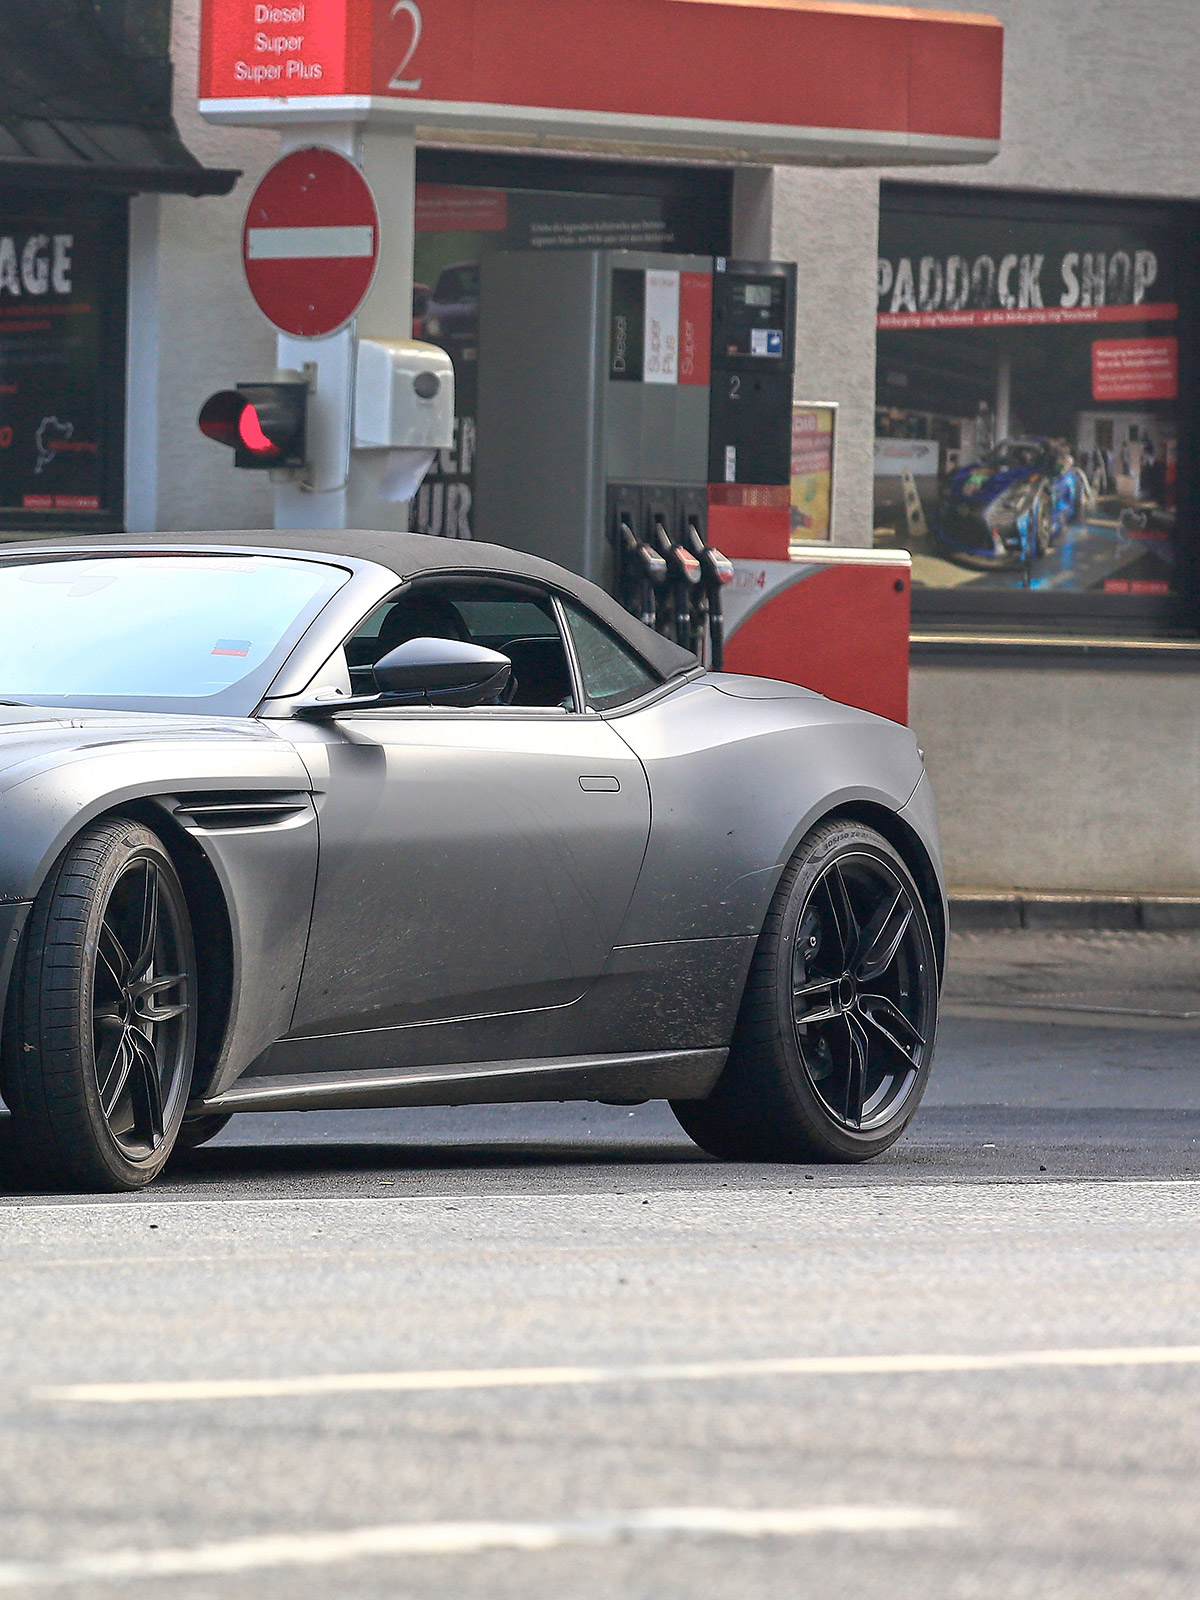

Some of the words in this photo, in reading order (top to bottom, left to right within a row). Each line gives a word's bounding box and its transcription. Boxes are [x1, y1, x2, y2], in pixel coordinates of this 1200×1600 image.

[254, 4, 305, 24] Diesel
[234, 60, 282, 83] Super
[286, 59, 323, 79] Plus
[254, 32, 304, 55] Super
[388, 0, 423, 91] 2
[878, 253, 1045, 313] PADDOCK
[1059, 250, 1158, 309] SHOP
[613, 315, 627, 373] Diesel
[648, 319, 661, 374] Super
[681, 320, 695, 376] Super
[729, 375, 741, 400] 2
